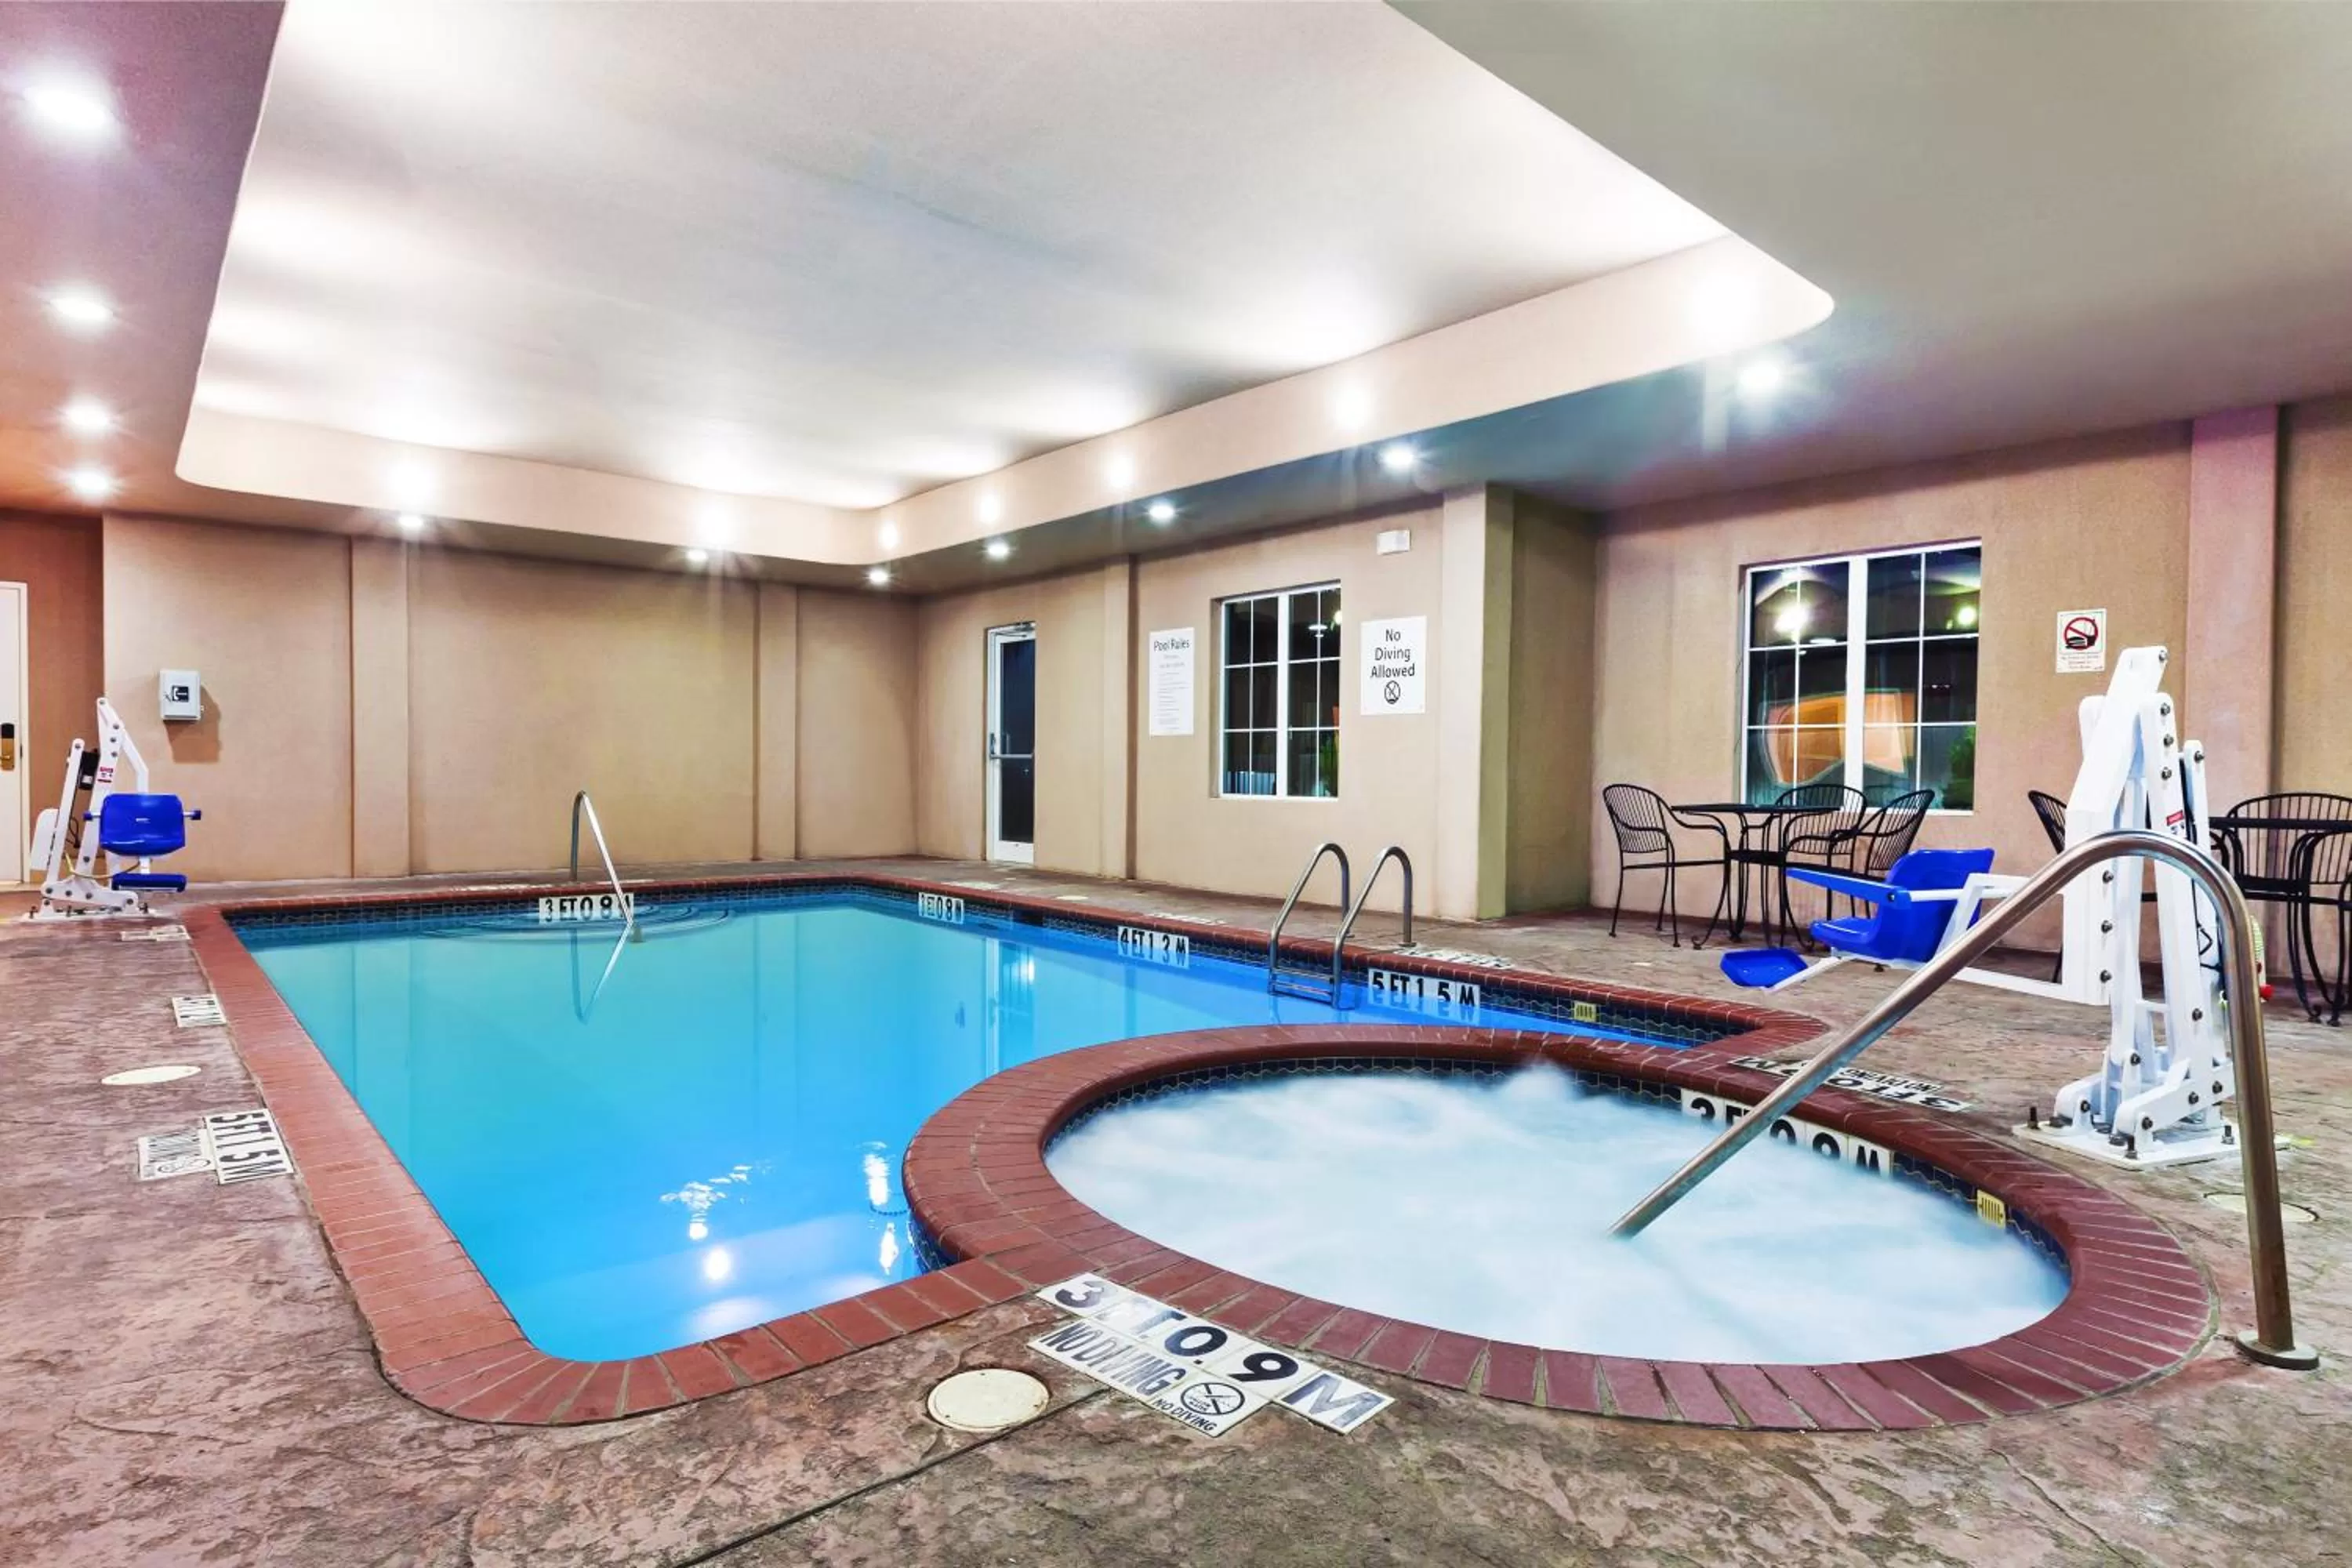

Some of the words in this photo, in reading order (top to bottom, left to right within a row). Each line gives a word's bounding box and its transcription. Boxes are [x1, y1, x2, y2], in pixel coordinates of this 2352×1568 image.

[1385, 629, 1401, 641] No
[1374, 646, 1411, 662] Diving
[1370, 663, 1415, 678] Allowed
[1039, 1321, 1103, 1352] NO
[1071, 1337, 1187, 1396] DIVING
[1281, 1374, 1385, 1428] M
[1152, 1398, 1174, 1410] NO
[1171, 1406, 1218, 1431] DIVING
